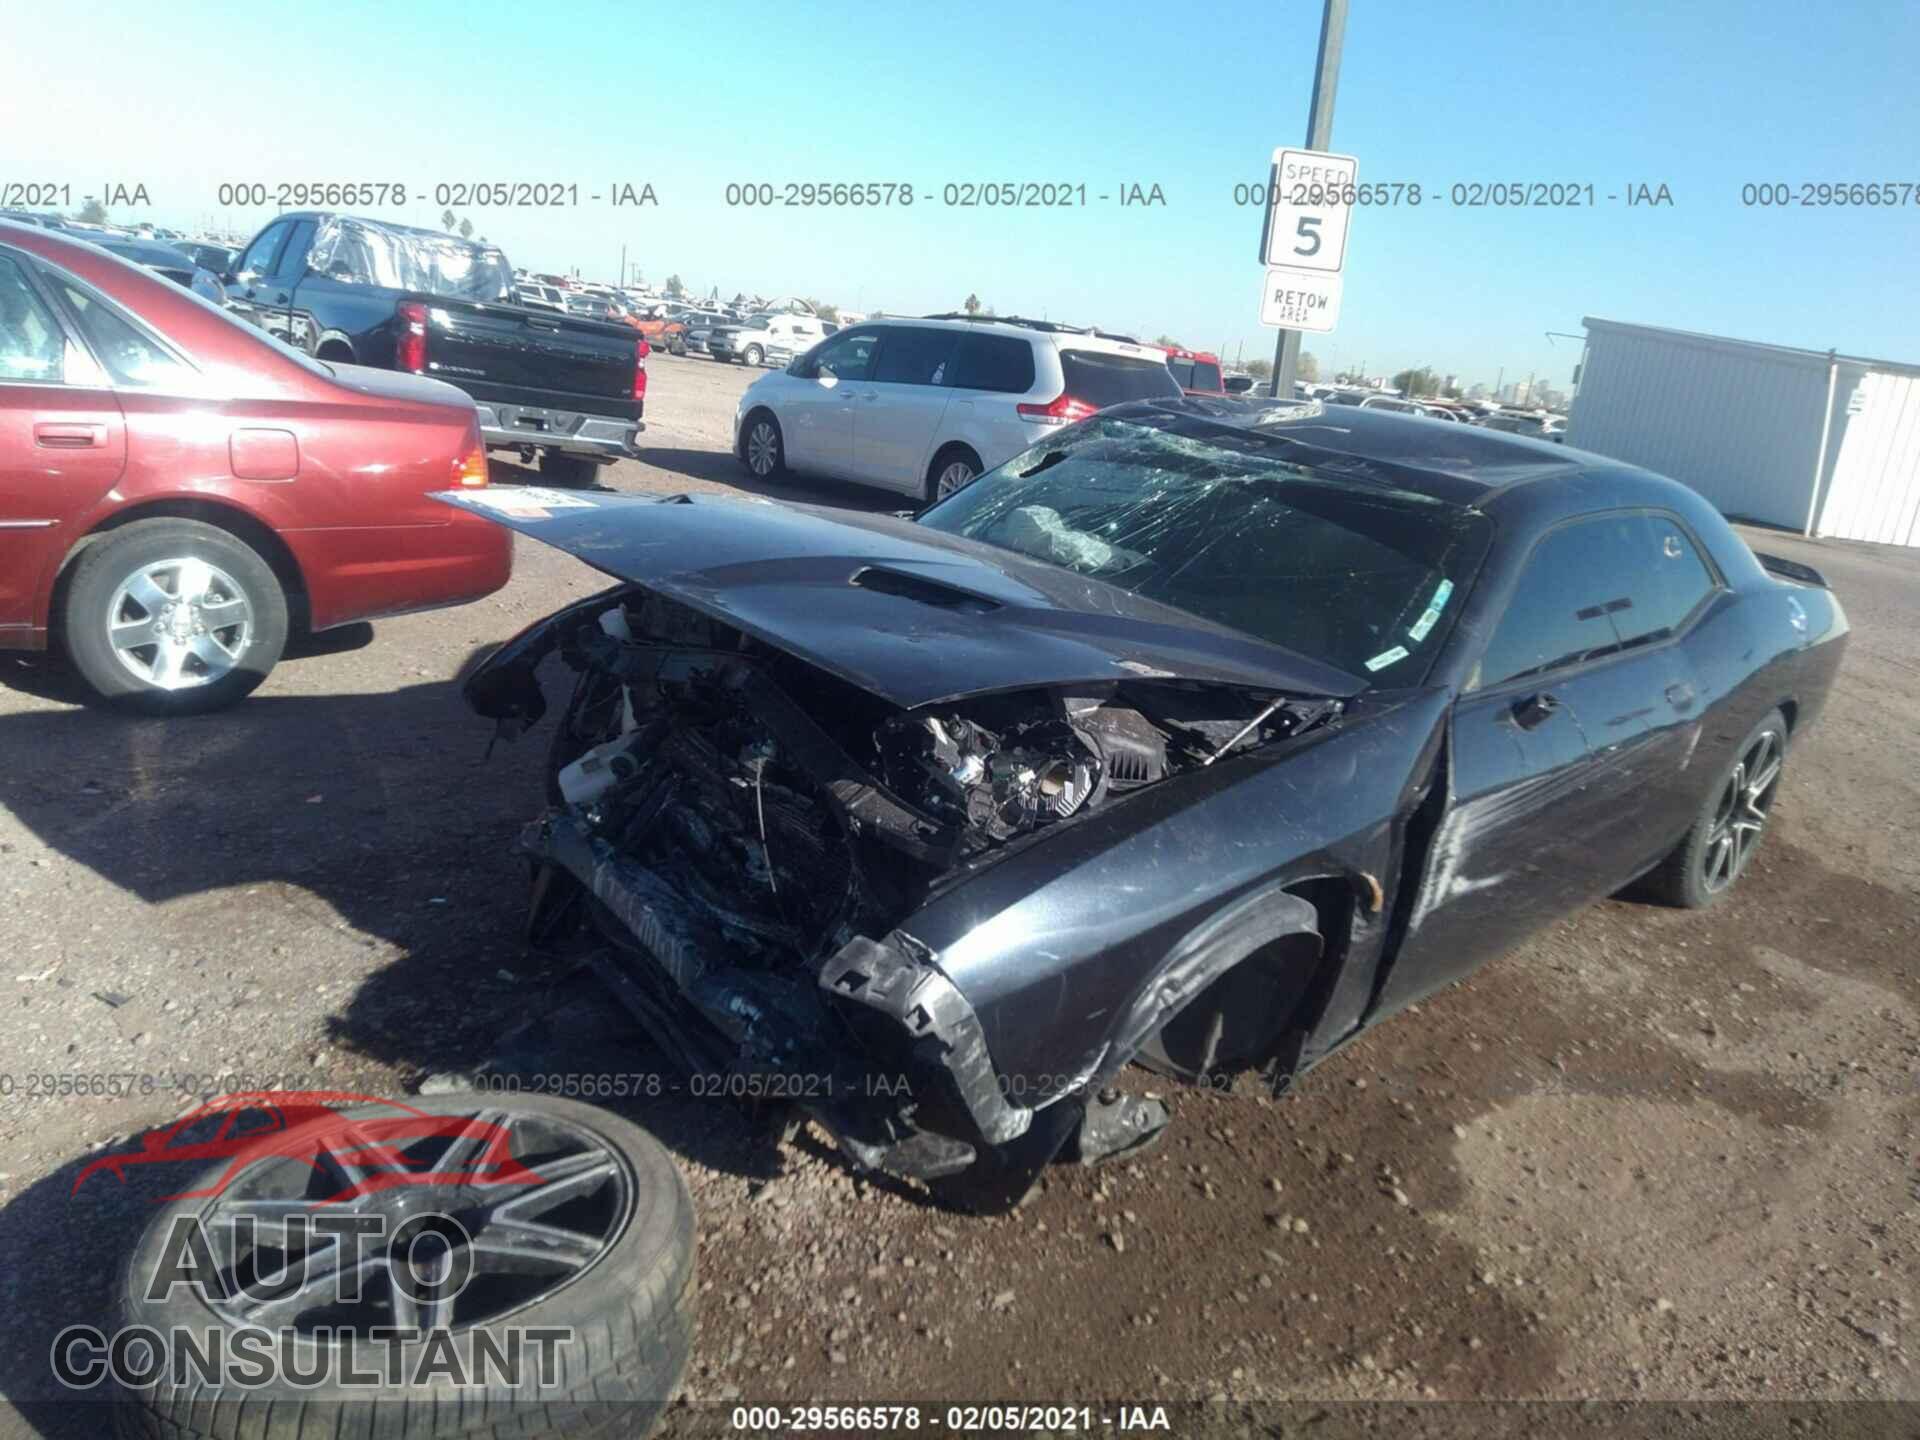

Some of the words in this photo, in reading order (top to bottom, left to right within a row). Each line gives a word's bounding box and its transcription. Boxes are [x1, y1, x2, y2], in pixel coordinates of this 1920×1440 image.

[1286, 163, 1350, 186] SPEED
[1293, 216, 1322, 257] 5
[1274, 288, 1328, 310] RETOW
